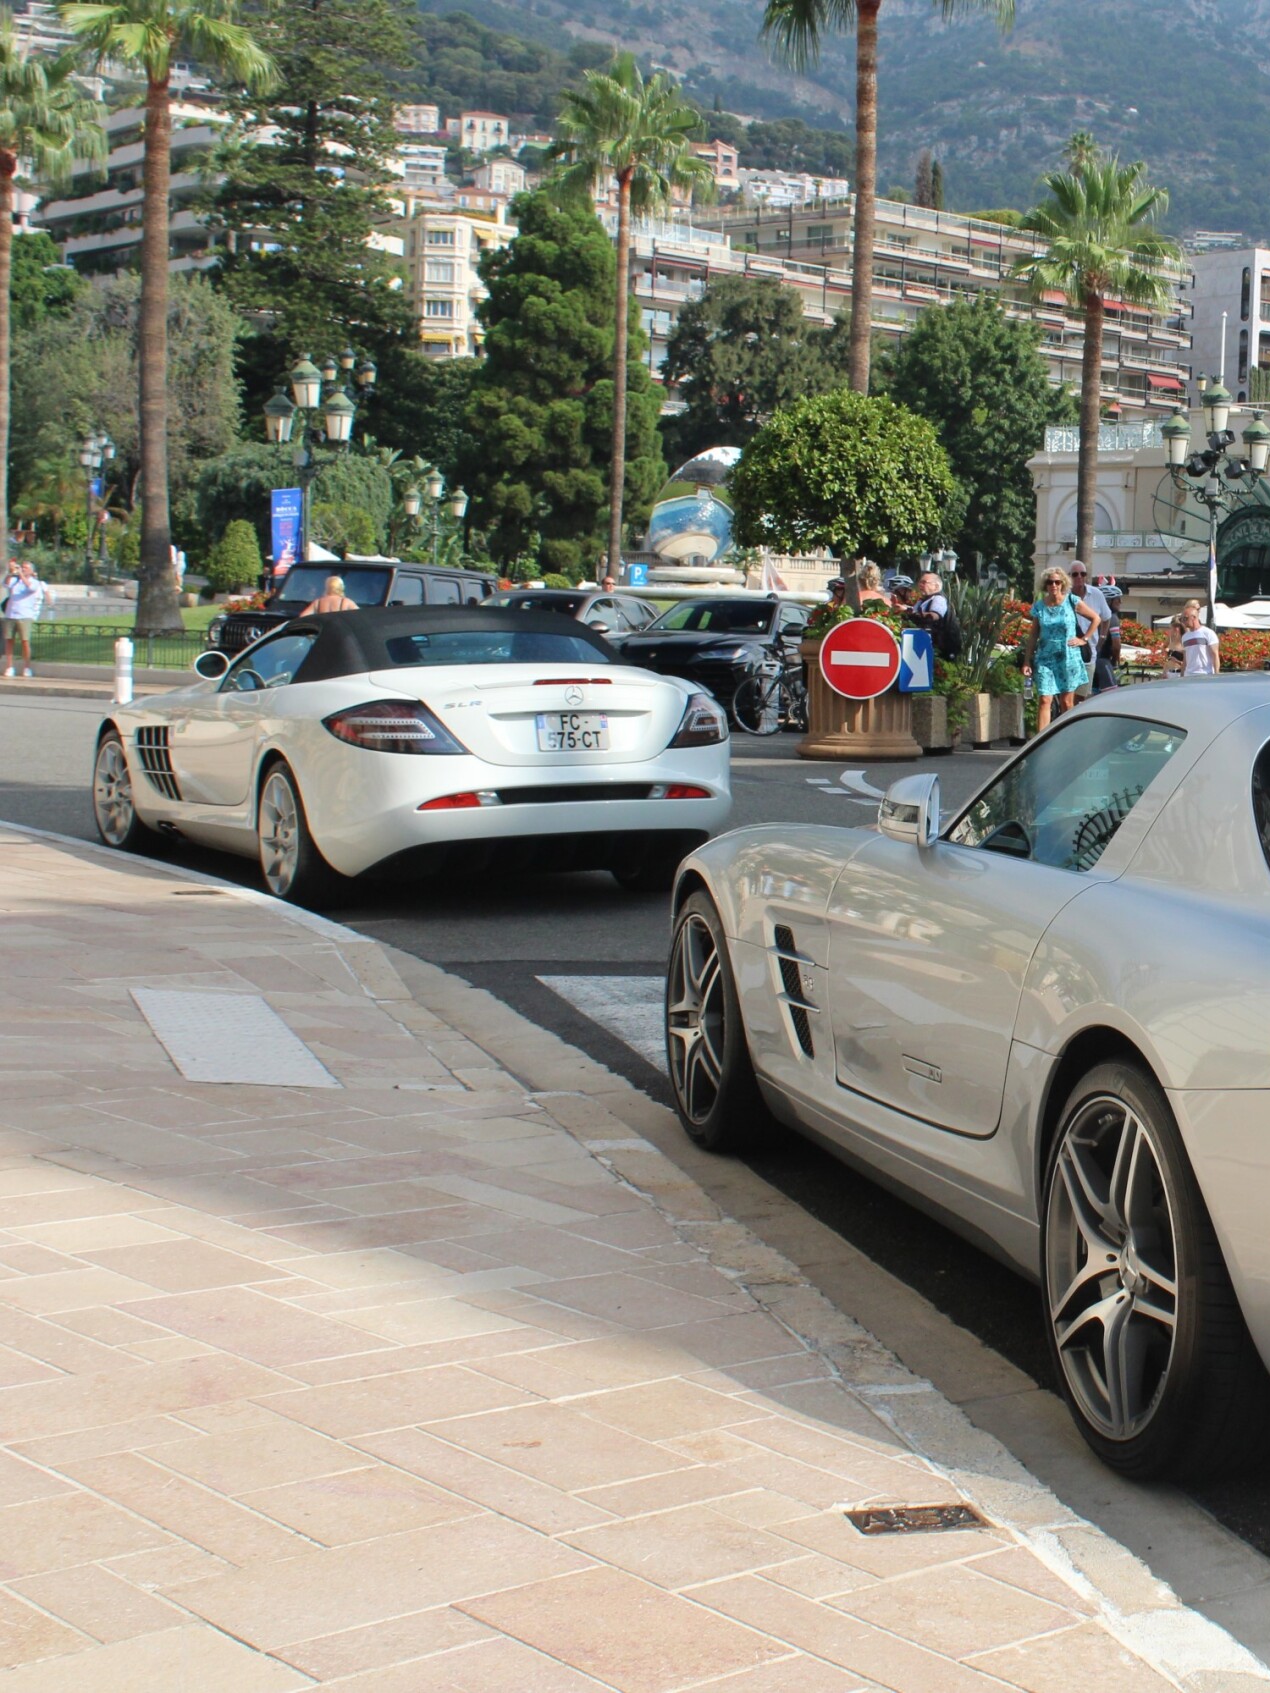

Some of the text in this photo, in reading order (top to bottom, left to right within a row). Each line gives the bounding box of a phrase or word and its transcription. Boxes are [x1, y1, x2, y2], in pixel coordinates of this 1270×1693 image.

[634, 566, 642, 580] P
[444, 700, 483, 710] SLR
[548, 731, 601, 749] 575-CT
